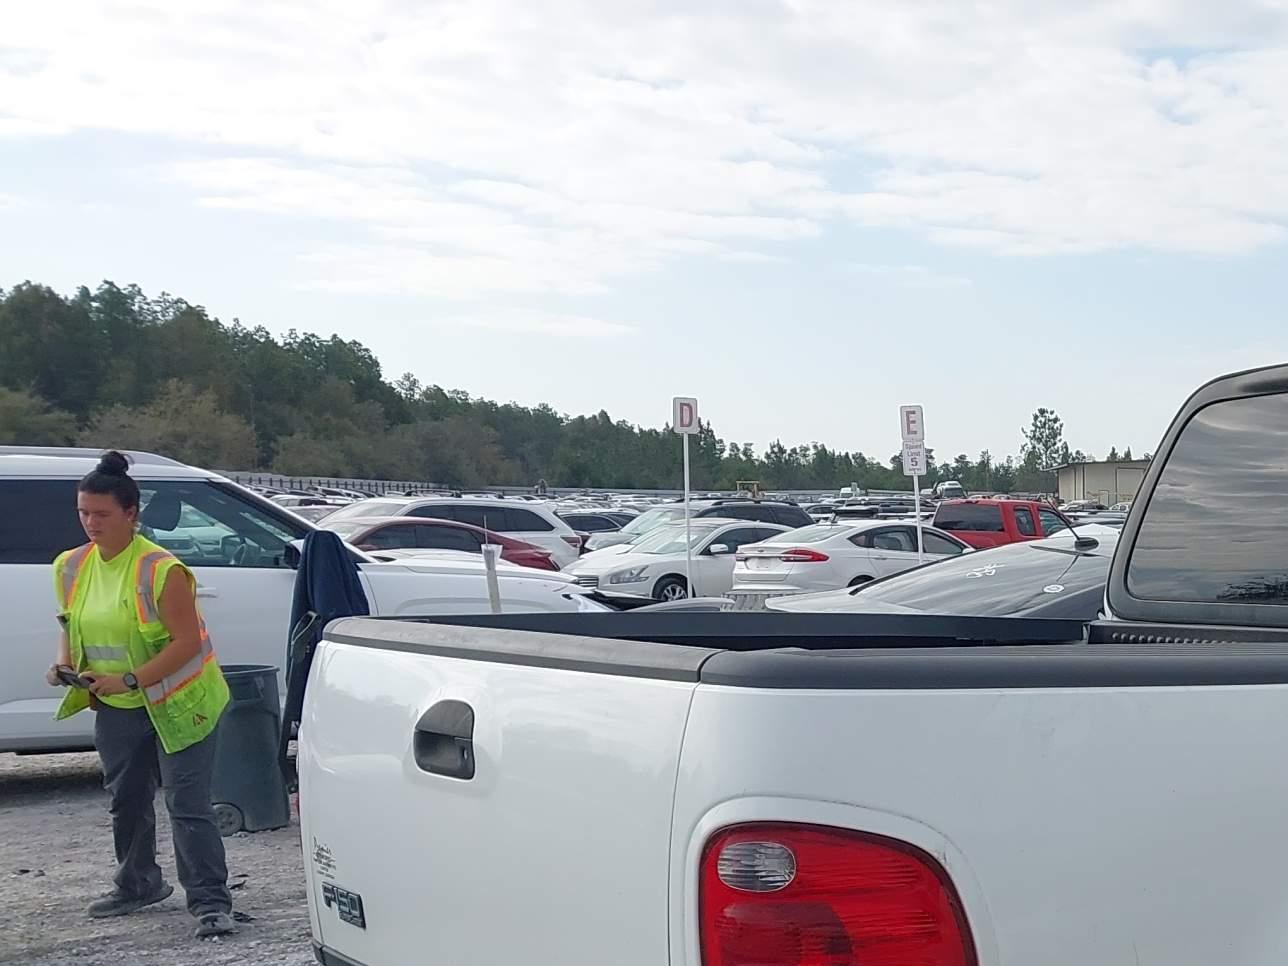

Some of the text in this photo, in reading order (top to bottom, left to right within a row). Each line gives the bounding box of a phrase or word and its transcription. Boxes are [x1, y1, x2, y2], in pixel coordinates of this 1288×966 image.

[680, 402, 694, 428] D
[906, 410, 918, 435] E
[910, 457, 918, 467] 5
